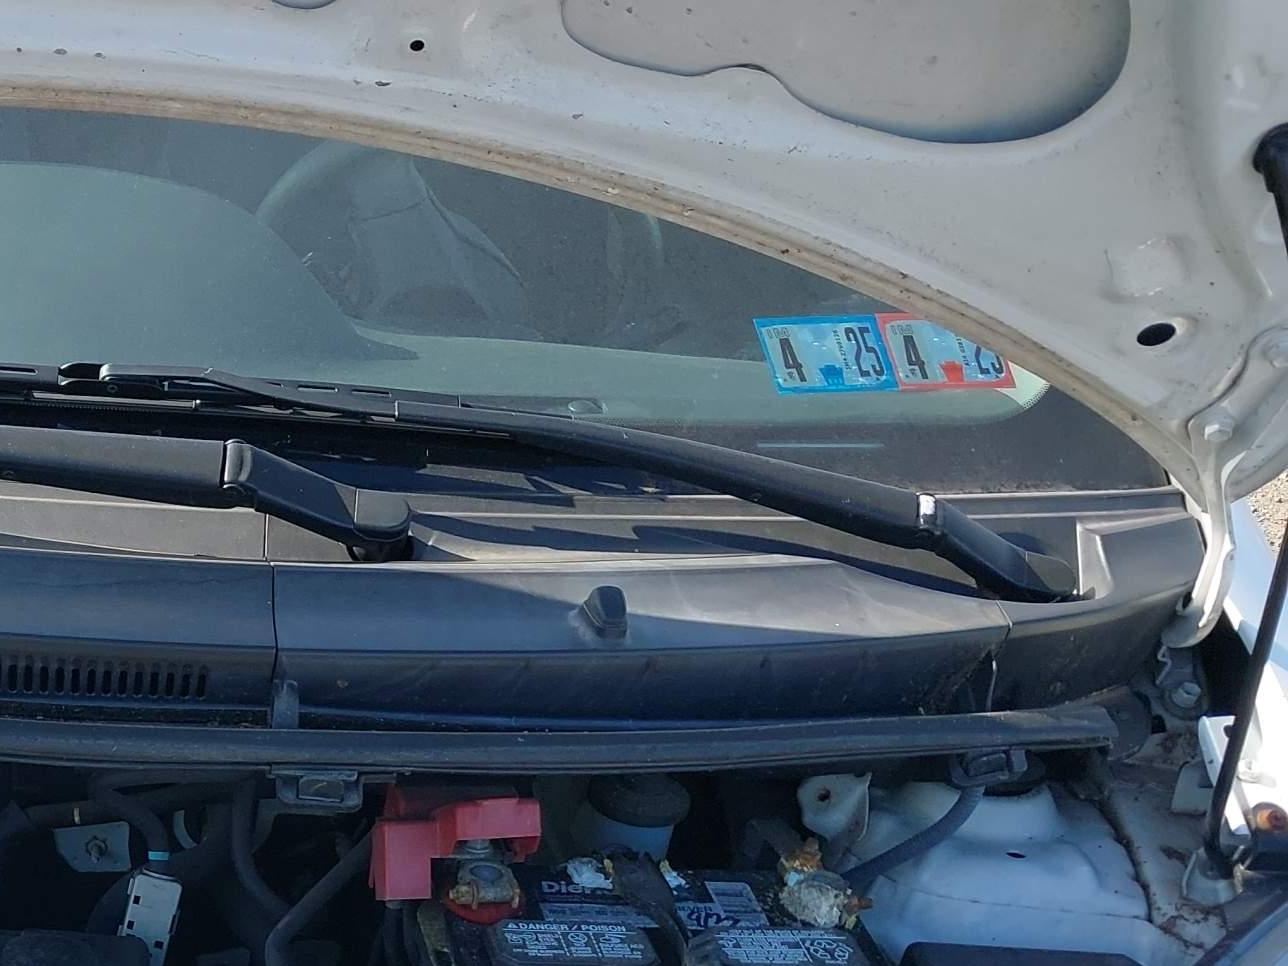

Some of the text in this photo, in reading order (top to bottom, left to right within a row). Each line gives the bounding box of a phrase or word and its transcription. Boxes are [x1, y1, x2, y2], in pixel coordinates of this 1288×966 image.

[780, 338, 808, 382] 4
[844, 326, 885, 378] 25
[903, 335, 929, 380] 4
[518, 922, 569, 931] DANGER
[581, 924, 626, 932] POISON
